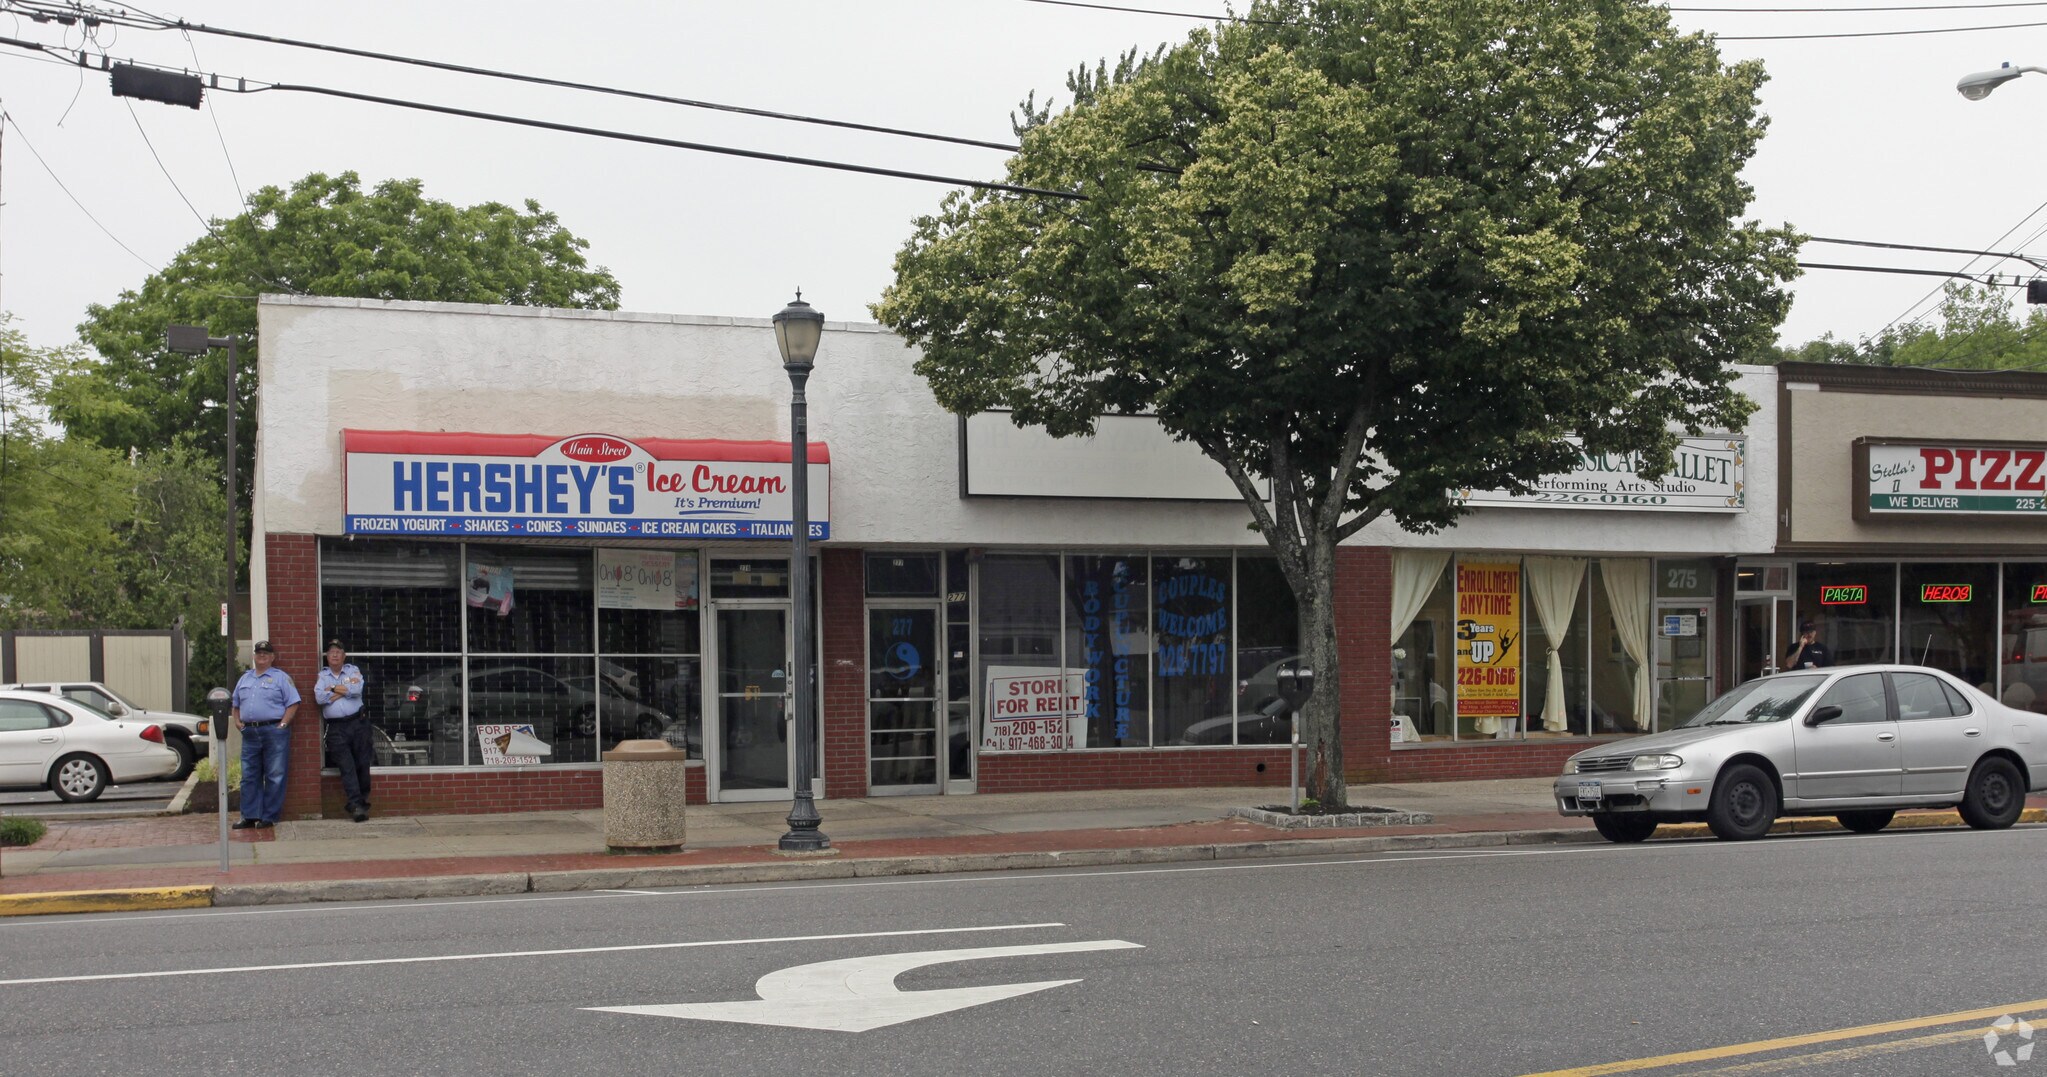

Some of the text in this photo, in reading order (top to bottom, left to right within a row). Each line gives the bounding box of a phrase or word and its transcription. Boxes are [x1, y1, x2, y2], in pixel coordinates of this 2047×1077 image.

[563, 441, 628, 456] Main Street
[647, 461, 787, 494] Ice Cream
[1870, 460, 1916, 483] Stella's
[1920, 448, 2046, 491] PIZZ
[393, 461, 634, 515] HERSHEY'S
[1615, 481, 1647, 492] Arts
[1652, 480, 1697, 493] Studio
[674, 496, 761, 509] It's Premium!
[1535, 493, 1668, 505] 226-0160
[1889, 496, 1959, 508] WE DELIVER
[353, 518, 398, 531] FROZEN
[402, 518, 446, 531] YOGURT
[464, 519, 509, 532] SHAKES
[526, 520, 562, 533] CONES
[577, 521, 627, 534] SUNDAES
[641, 522, 658, 534] ICE
[661, 522, 699, 535] CREAM
[702, 523, 737, 535] CAKES
[751, 523, 794, 536] ITALIAN
[1457, 565, 1518, 594] ENROLLMENT
[1667, 568, 1698, 589] 275
[948, 592, 967, 602] 277
[1158, 575, 1226, 604] COUPLES
[1825, 587, 1864, 601] PASTA
[1923, 586, 1969, 600] HEROS
[1460, 594, 1512, 615] ANYTIME
[892, 617, 913, 636] 277
[1158, 606, 1227, 639] WELCOME
[1457, 619, 1495, 640] 3 Years
[1084, 580, 1103, 718] BODYWORK
[1457, 641, 1495, 663] and UP
[1158, 643, 1226, 676] 226-7797
[1457, 667, 1517, 686] 226-0160
[997, 698, 1029, 714] FOR
[478, 725, 501, 735] FOR
[1008, 735, 1074, 751] 917-468-304
[485, 756, 538, 765] 718-209-1521
